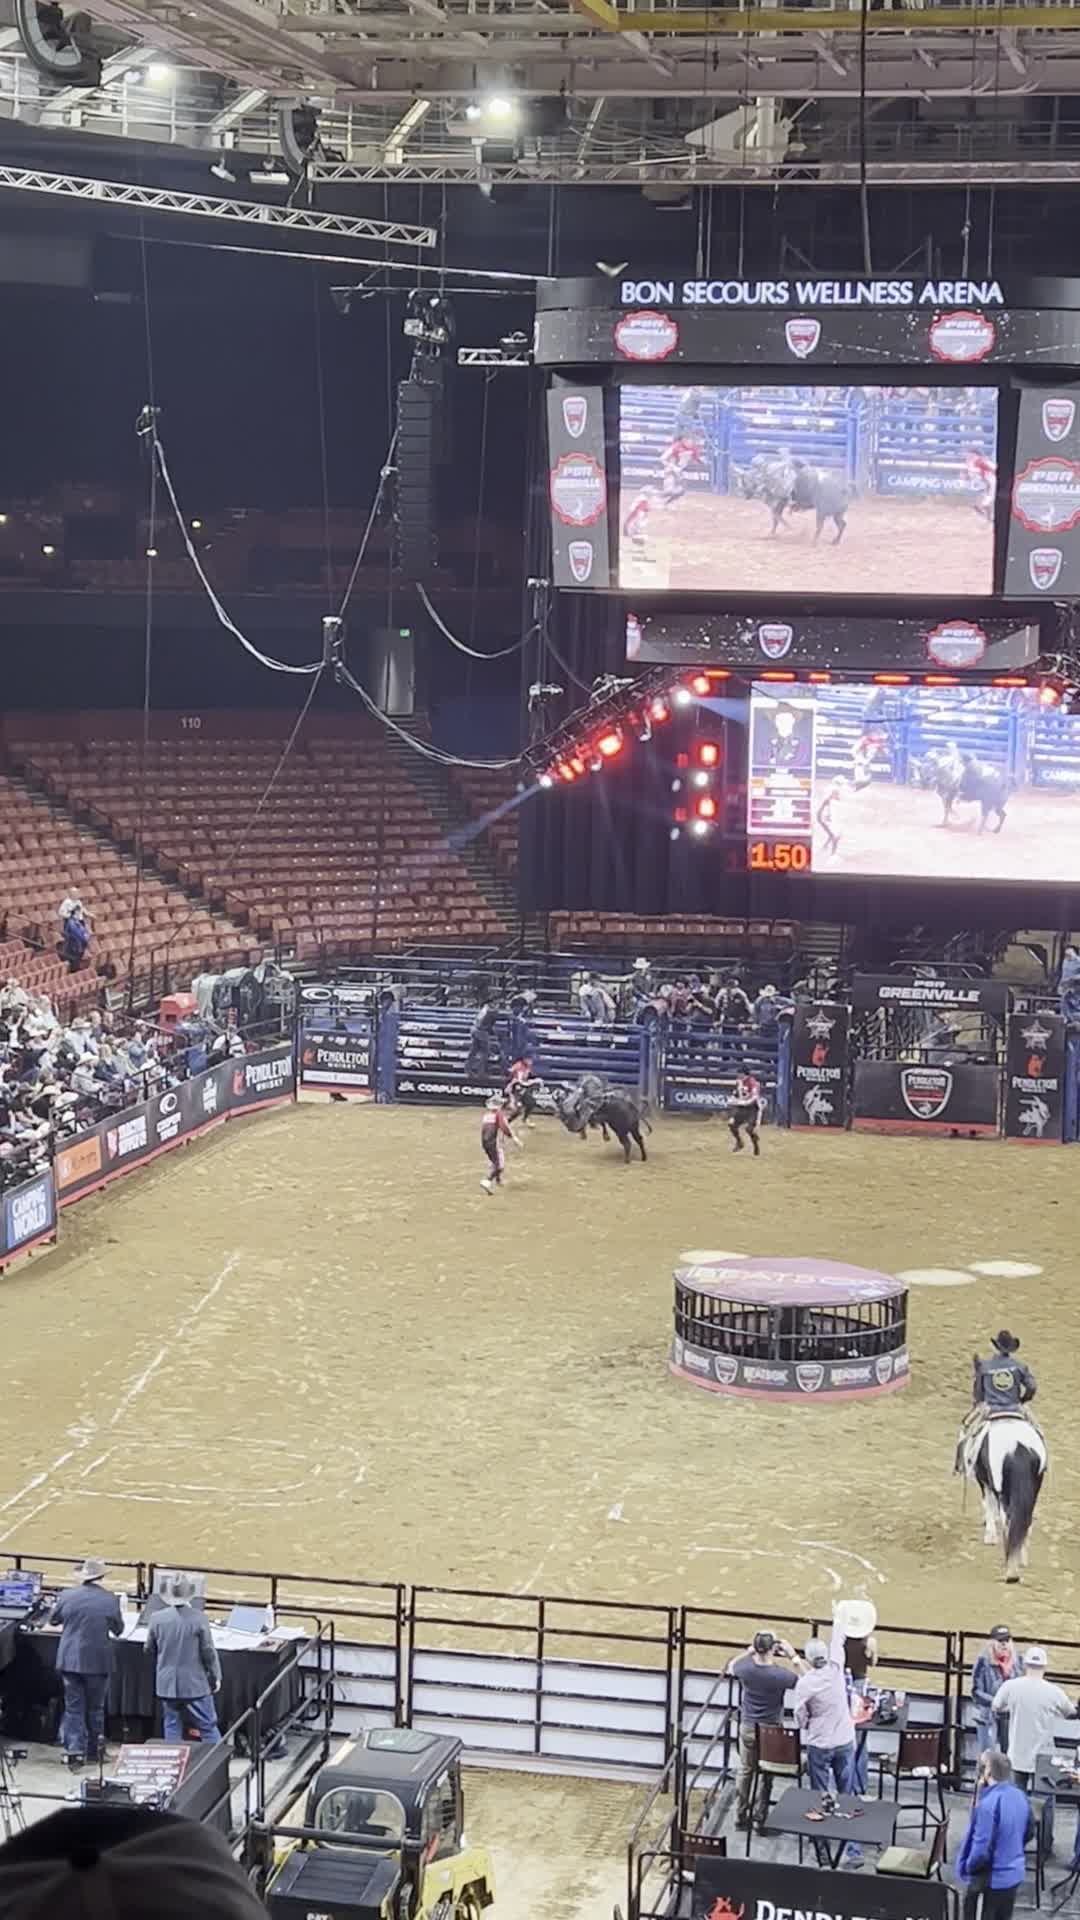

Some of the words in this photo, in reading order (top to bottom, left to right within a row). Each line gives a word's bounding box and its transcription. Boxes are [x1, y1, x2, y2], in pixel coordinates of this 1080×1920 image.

[621, 281, 674, 304] BON
[682, 281, 789, 304] SECOURS
[795, 281, 914, 304] WELLNESS
[918, 281, 1004, 304] ARENA
[181, 716, 201, 729] 110
[751, 842, 807, 869] 1.50
[879, 986, 980, 1002] GREENVILLE
[317, 1049, 369, 1067] PENDLETON
[245, 1056, 293, 1088] PENDLETON
[797, 1065, 841, 1079] PENDLETON
[417, 1082, 461, 1094] CORPUS
[1012, 1076, 1058, 1091] PENDLETON
[675, 1091, 728, 1106] CAMPING
[13, 1203, 47, 1240] WORLD
